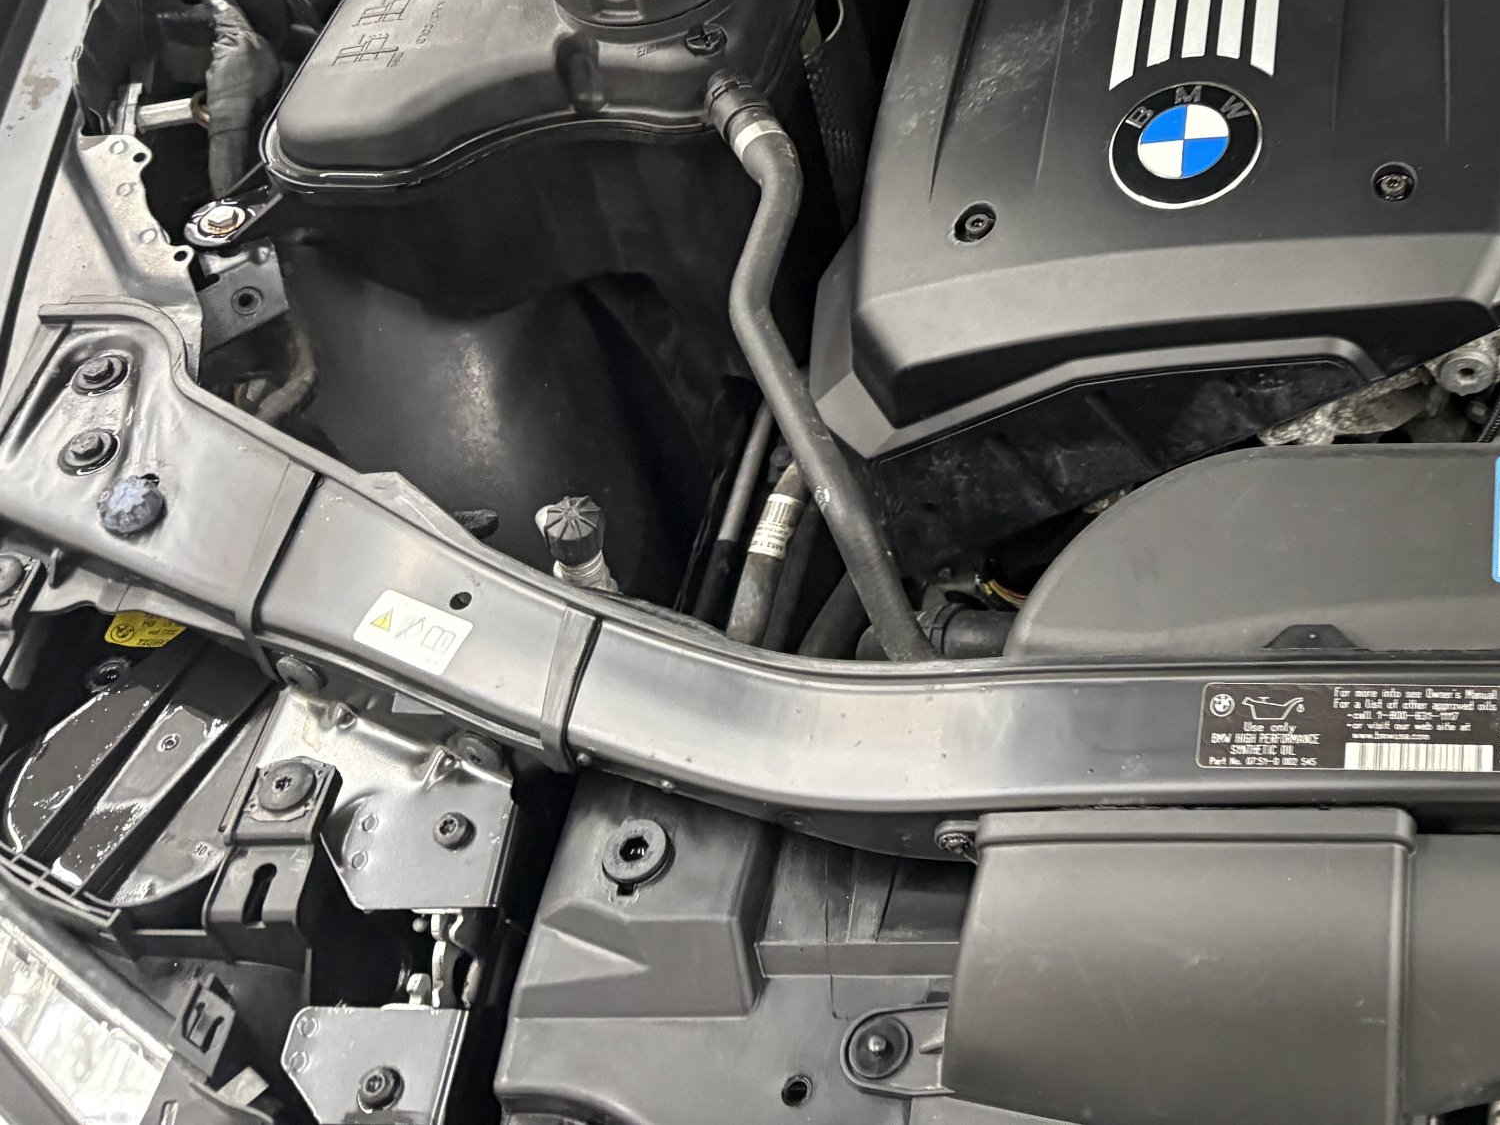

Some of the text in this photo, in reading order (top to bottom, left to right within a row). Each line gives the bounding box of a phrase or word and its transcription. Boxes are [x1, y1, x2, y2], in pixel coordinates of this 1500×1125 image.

[1125, 85, 1251, 129] BMW
[1243, 721, 1298, 734] Use only
[1210, 733, 1321, 745] BMW HIGH PERFORMANCE
[1229, 744, 1297, 755] SYNTHETIC OIL
[1208, 756, 1228, 766] Part
